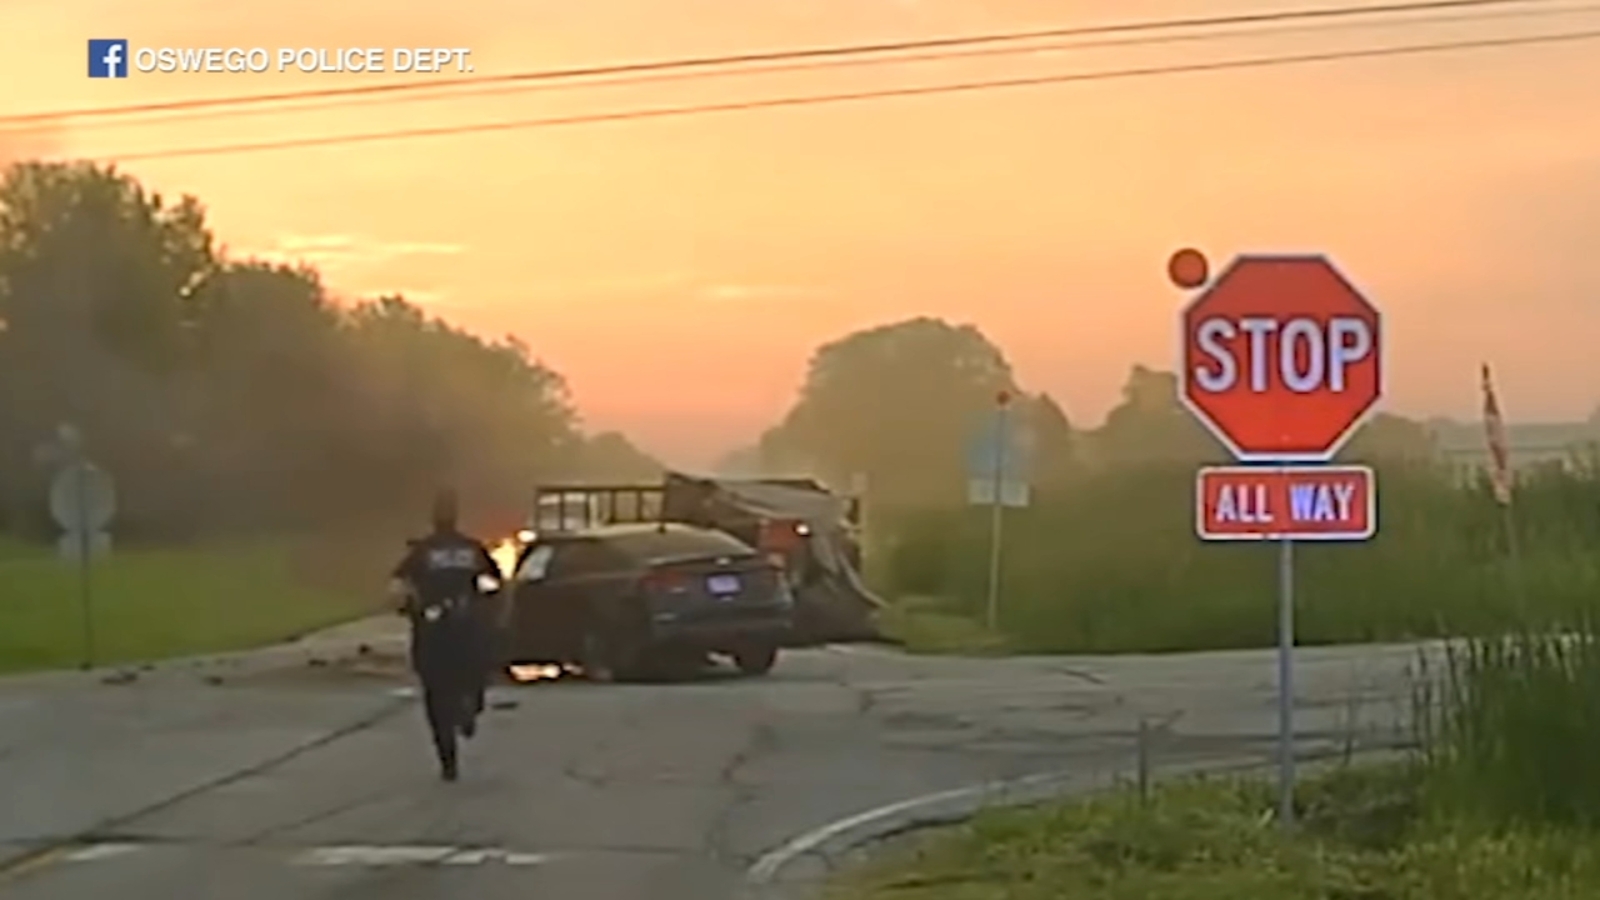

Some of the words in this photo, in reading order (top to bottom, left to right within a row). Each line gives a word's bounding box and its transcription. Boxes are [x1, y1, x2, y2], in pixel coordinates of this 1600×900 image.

[1195, 317, 1372, 393] STOP
[1215, 484, 1274, 522] ALL
[1290, 482, 1354, 521] WAY
